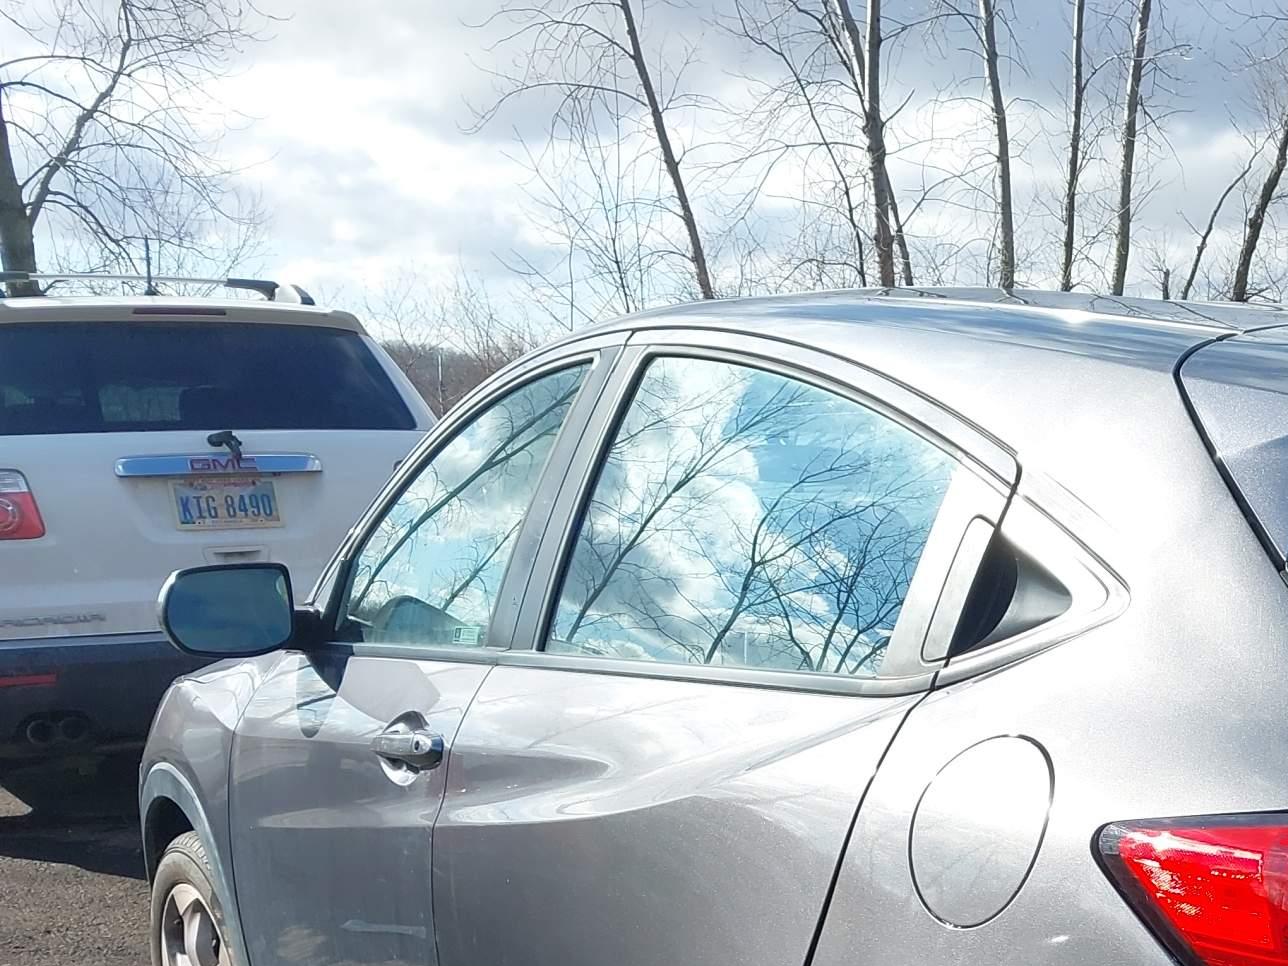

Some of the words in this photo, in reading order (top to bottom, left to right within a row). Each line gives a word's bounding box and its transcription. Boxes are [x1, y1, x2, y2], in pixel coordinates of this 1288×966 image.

[188, 457, 259, 472] GMC
[181, 495, 219, 522] KIG
[224, 494, 273, 519] 8490
